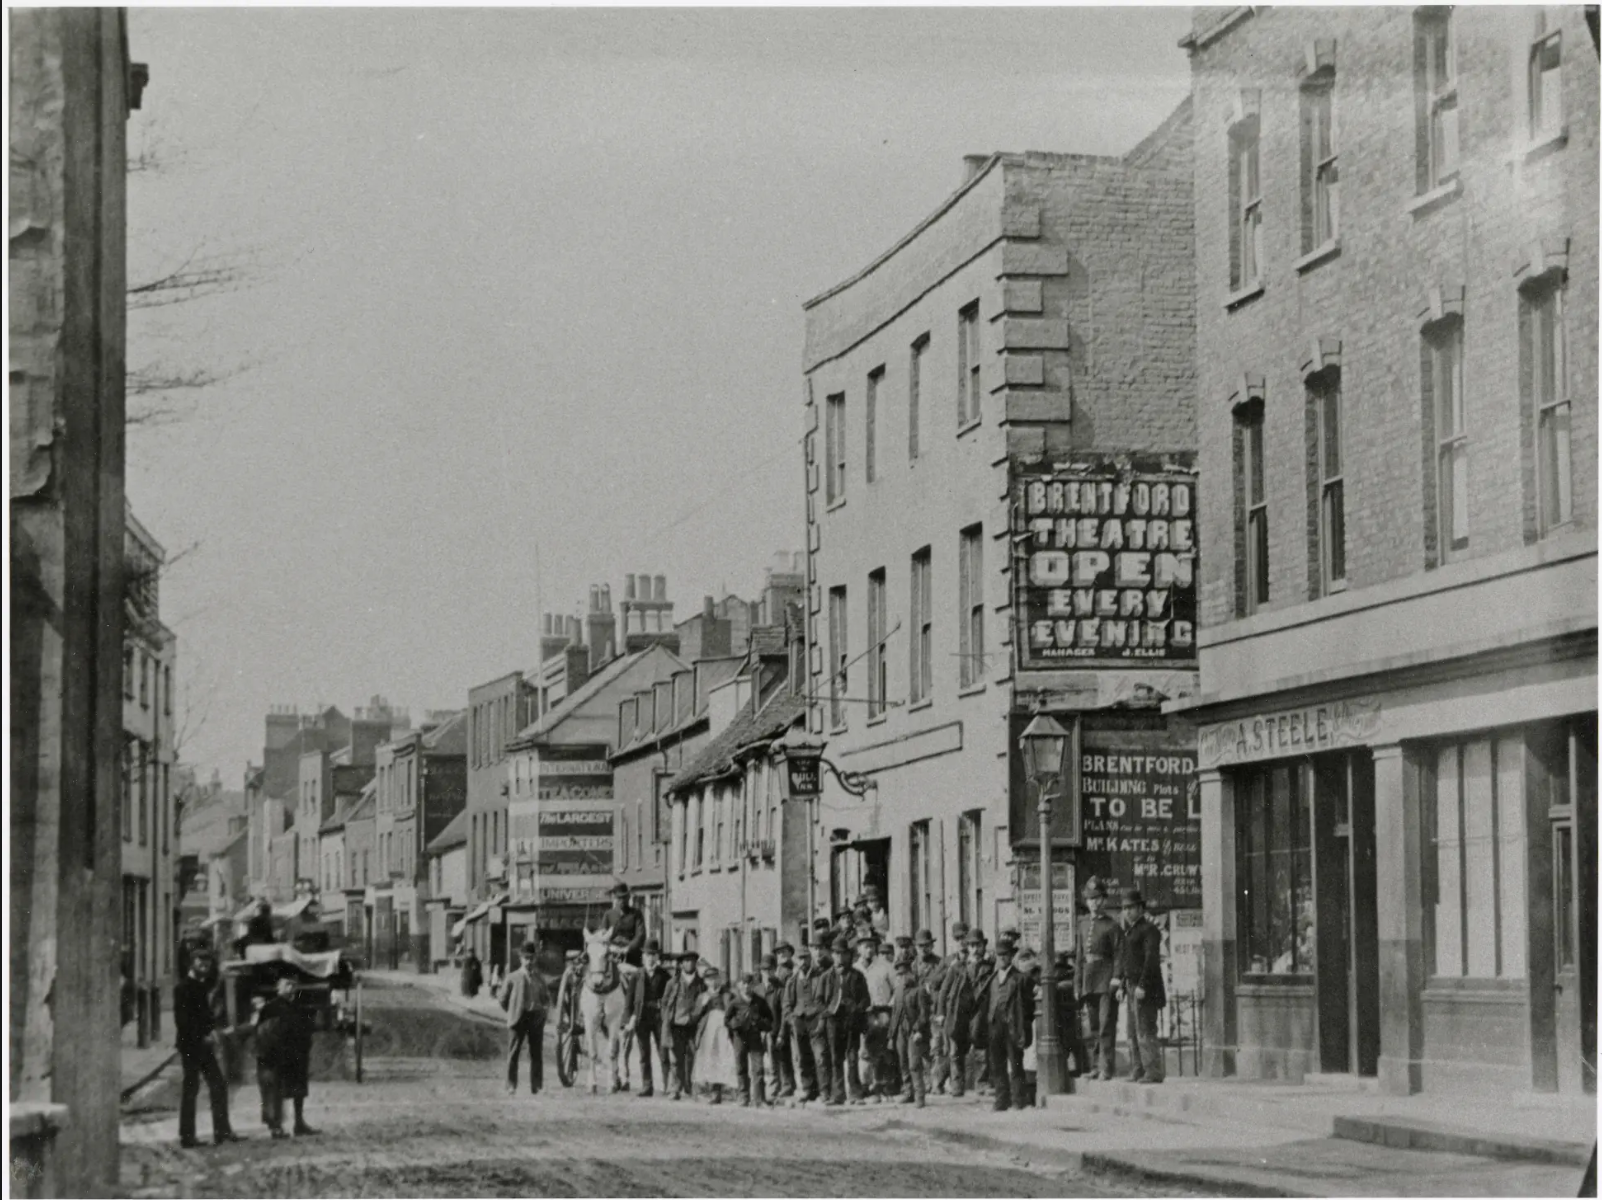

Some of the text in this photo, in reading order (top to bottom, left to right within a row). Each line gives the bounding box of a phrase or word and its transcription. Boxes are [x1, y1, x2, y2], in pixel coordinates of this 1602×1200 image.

[1028, 481, 1189, 517] BRENTFORD
[1029, 518, 1193, 550] THEATRE
[1029, 550, 1193, 588] OPEN
[1048, 588, 1168, 617] EVERY
[1030, 618, 1192, 648] EVENING
[1082, 755, 1195, 775] BRENTFORD
[1082, 776, 1147, 795] BUILDING
[557, 812, 612, 824] LARGEST
[1089, 797, 1201, 819] TO BE L
